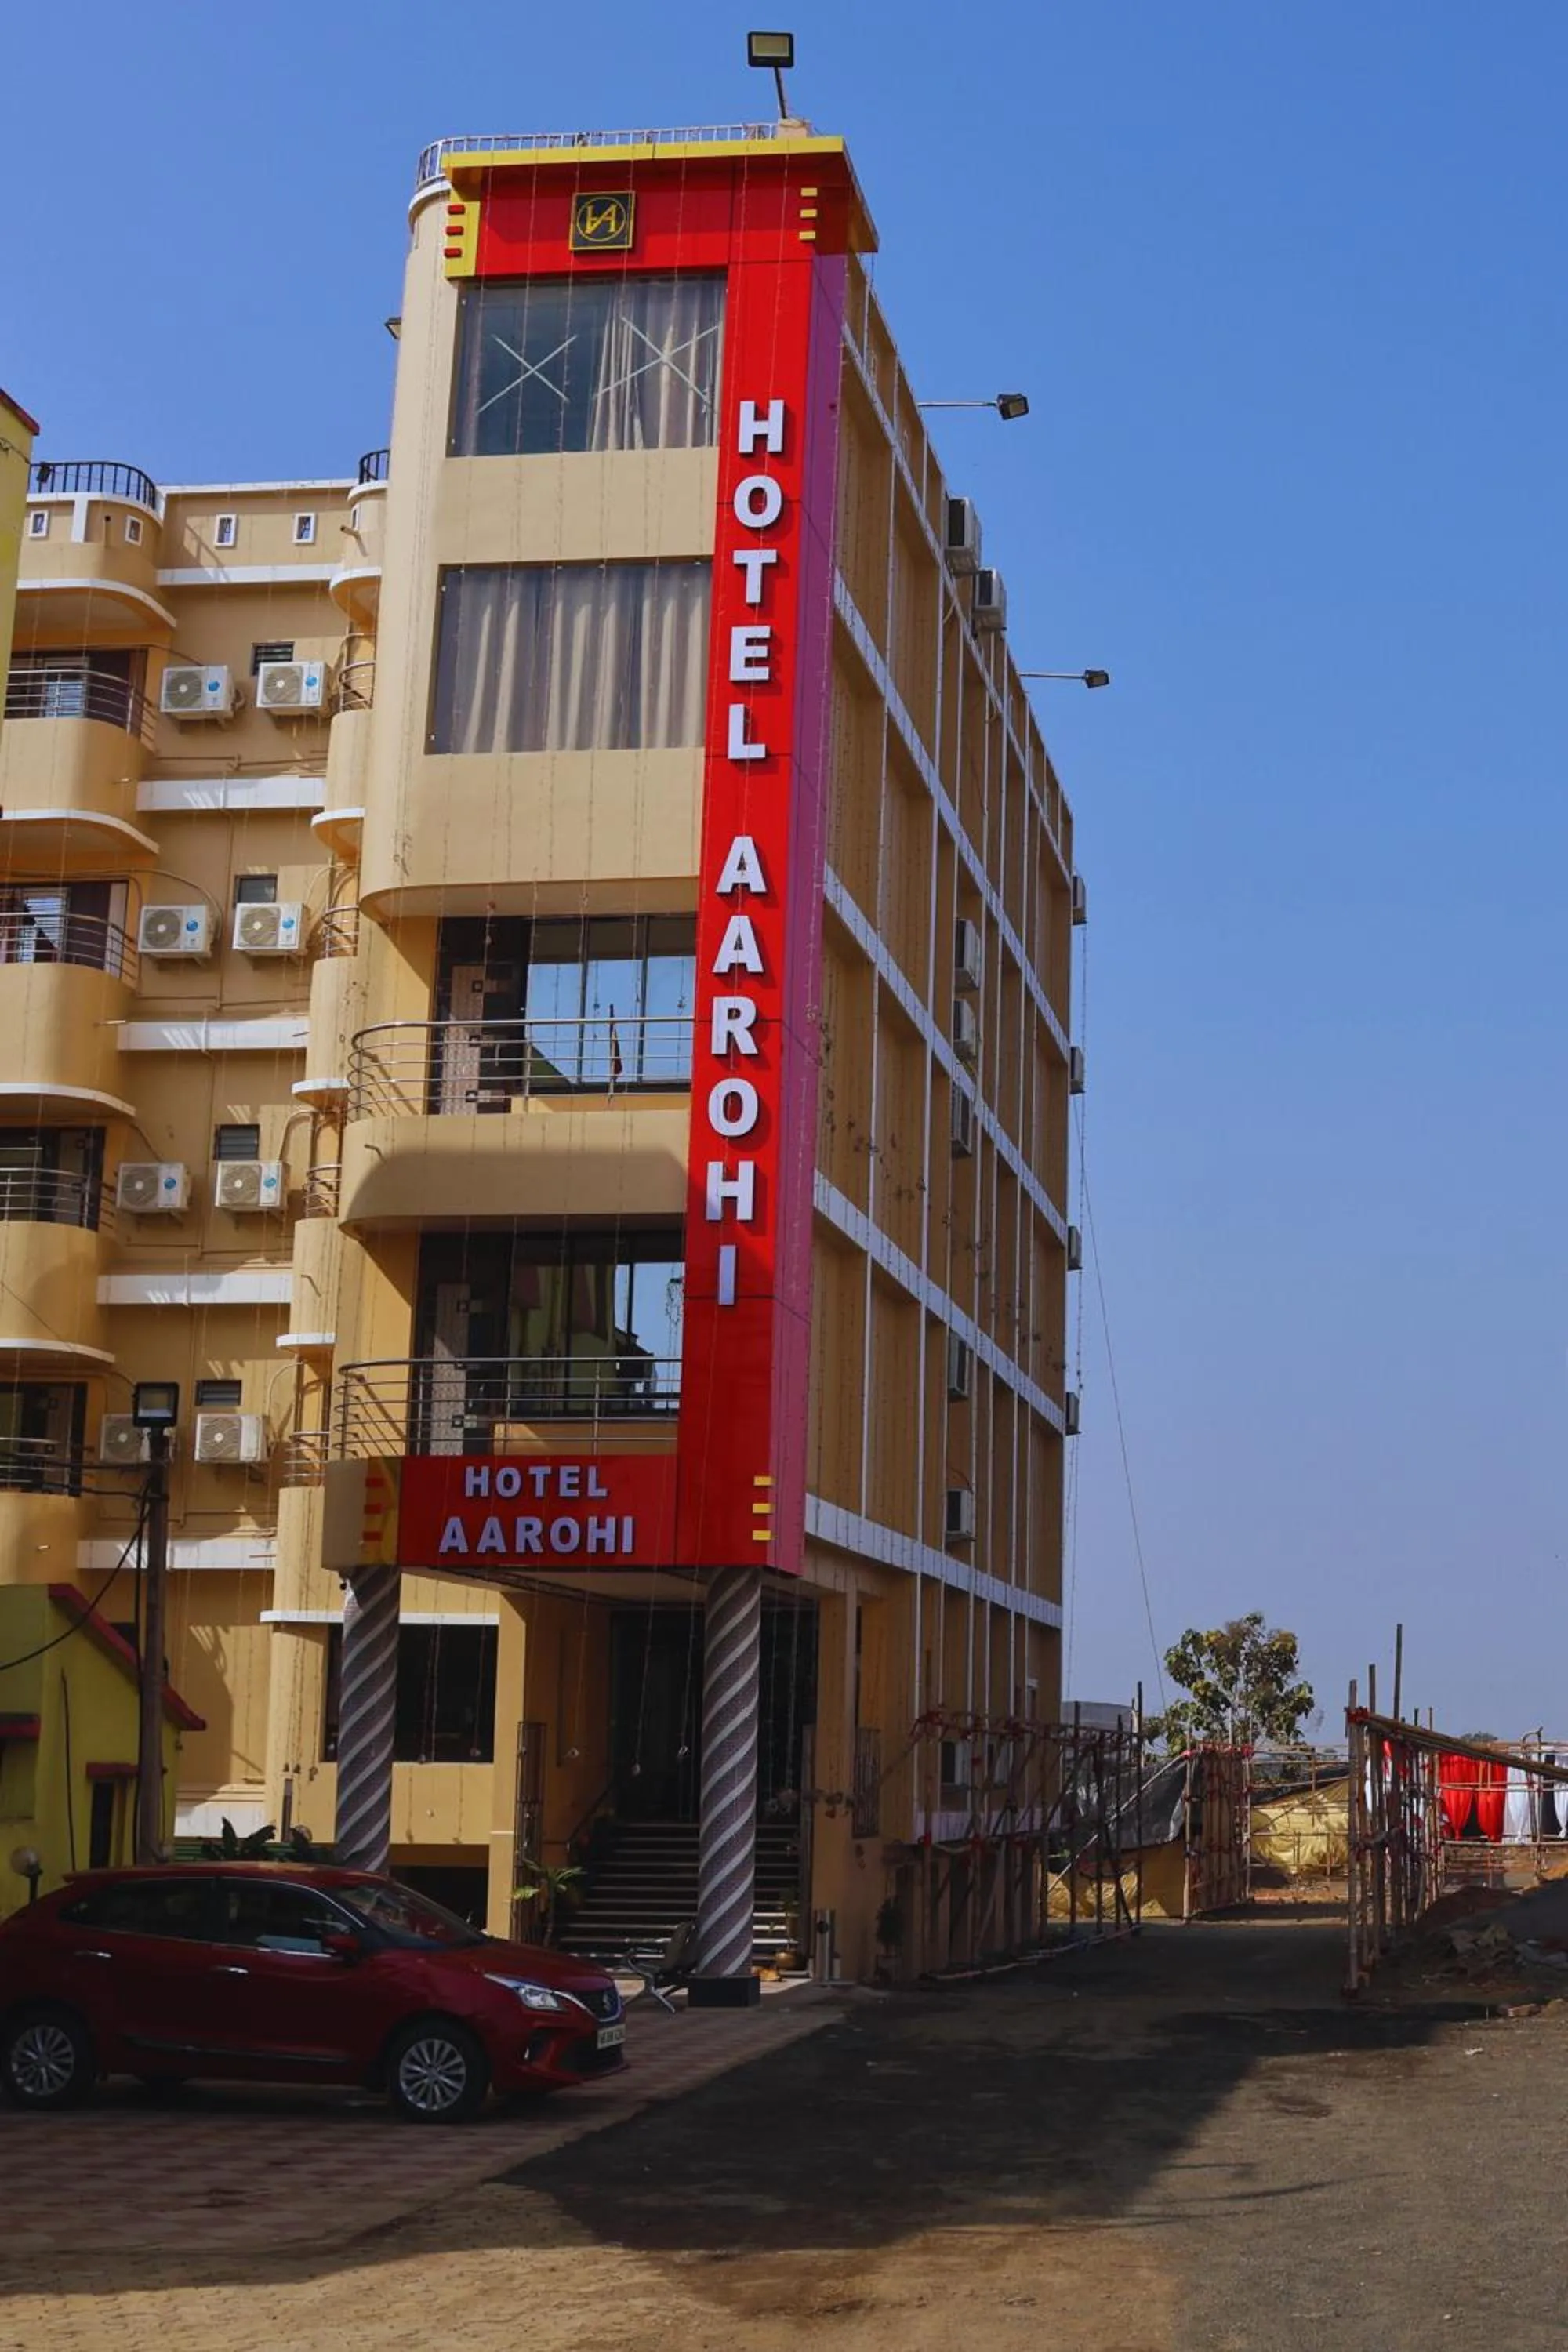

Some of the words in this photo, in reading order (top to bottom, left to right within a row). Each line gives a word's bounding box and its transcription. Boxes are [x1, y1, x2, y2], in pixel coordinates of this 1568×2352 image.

[726, 398, 785, 761] HOTEL
[706, 835, 768, 1305] AAROHI
[439, 1515, 634, 1554] AAROHI
[464, 1465, 608, 1498] HOTEL
